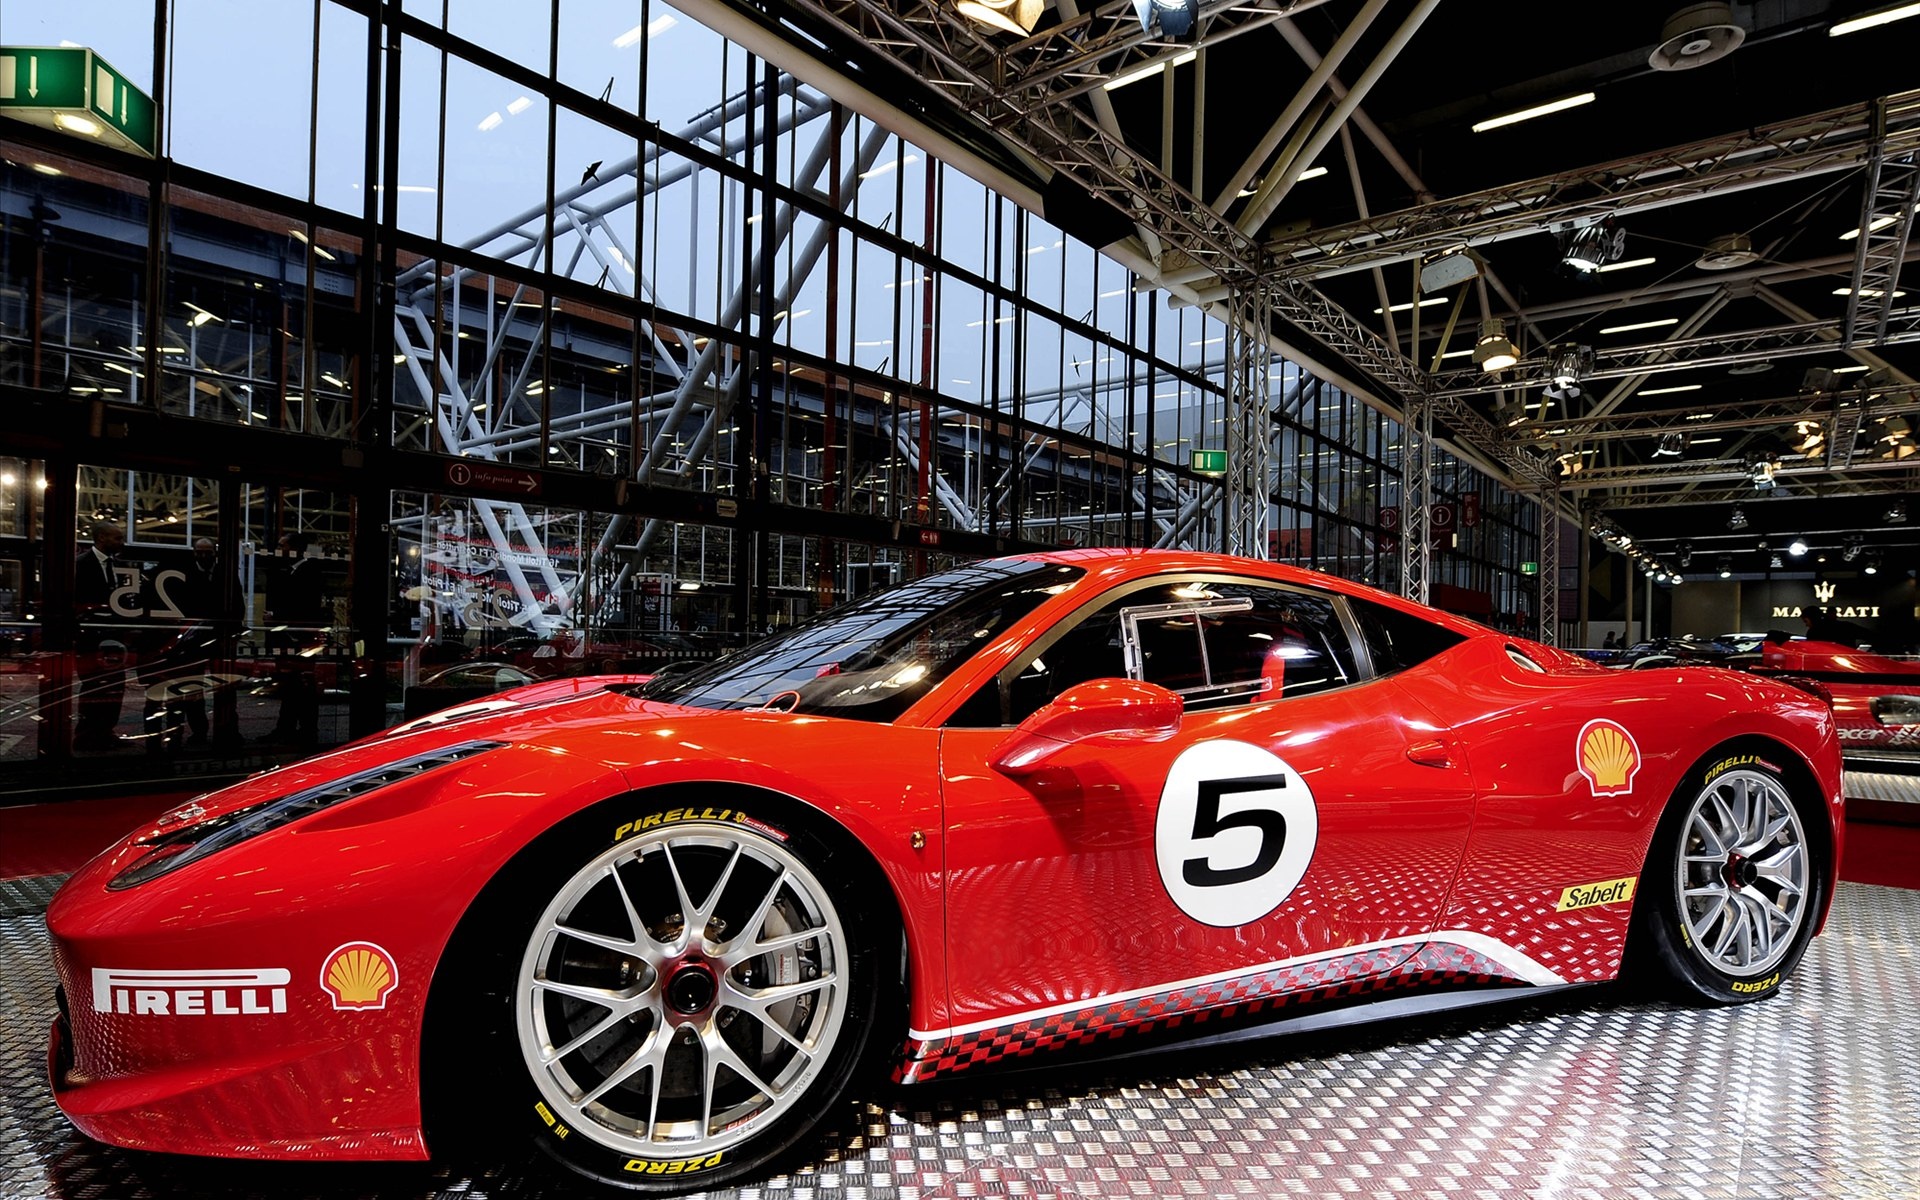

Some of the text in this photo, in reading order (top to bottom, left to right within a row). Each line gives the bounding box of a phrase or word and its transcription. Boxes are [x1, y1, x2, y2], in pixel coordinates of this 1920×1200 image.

[475, 472, 513, 484] info point
[1772, 606, 1880, 618] MARATI
[1836, 728, 1884, 740] acer
[1705, 755, 1754, 785] PIRELLI
[614, 807, 731, 842] PIRELLI
[1182, 773, 1287, 887] 5
[1566, 881, 1627, 908] Sabelt
[91, 967, 291, 1015] PIRELLI
[1731, 972, 1780, 993] PZERO
[623, 1151, 723, 1174] PZERO
